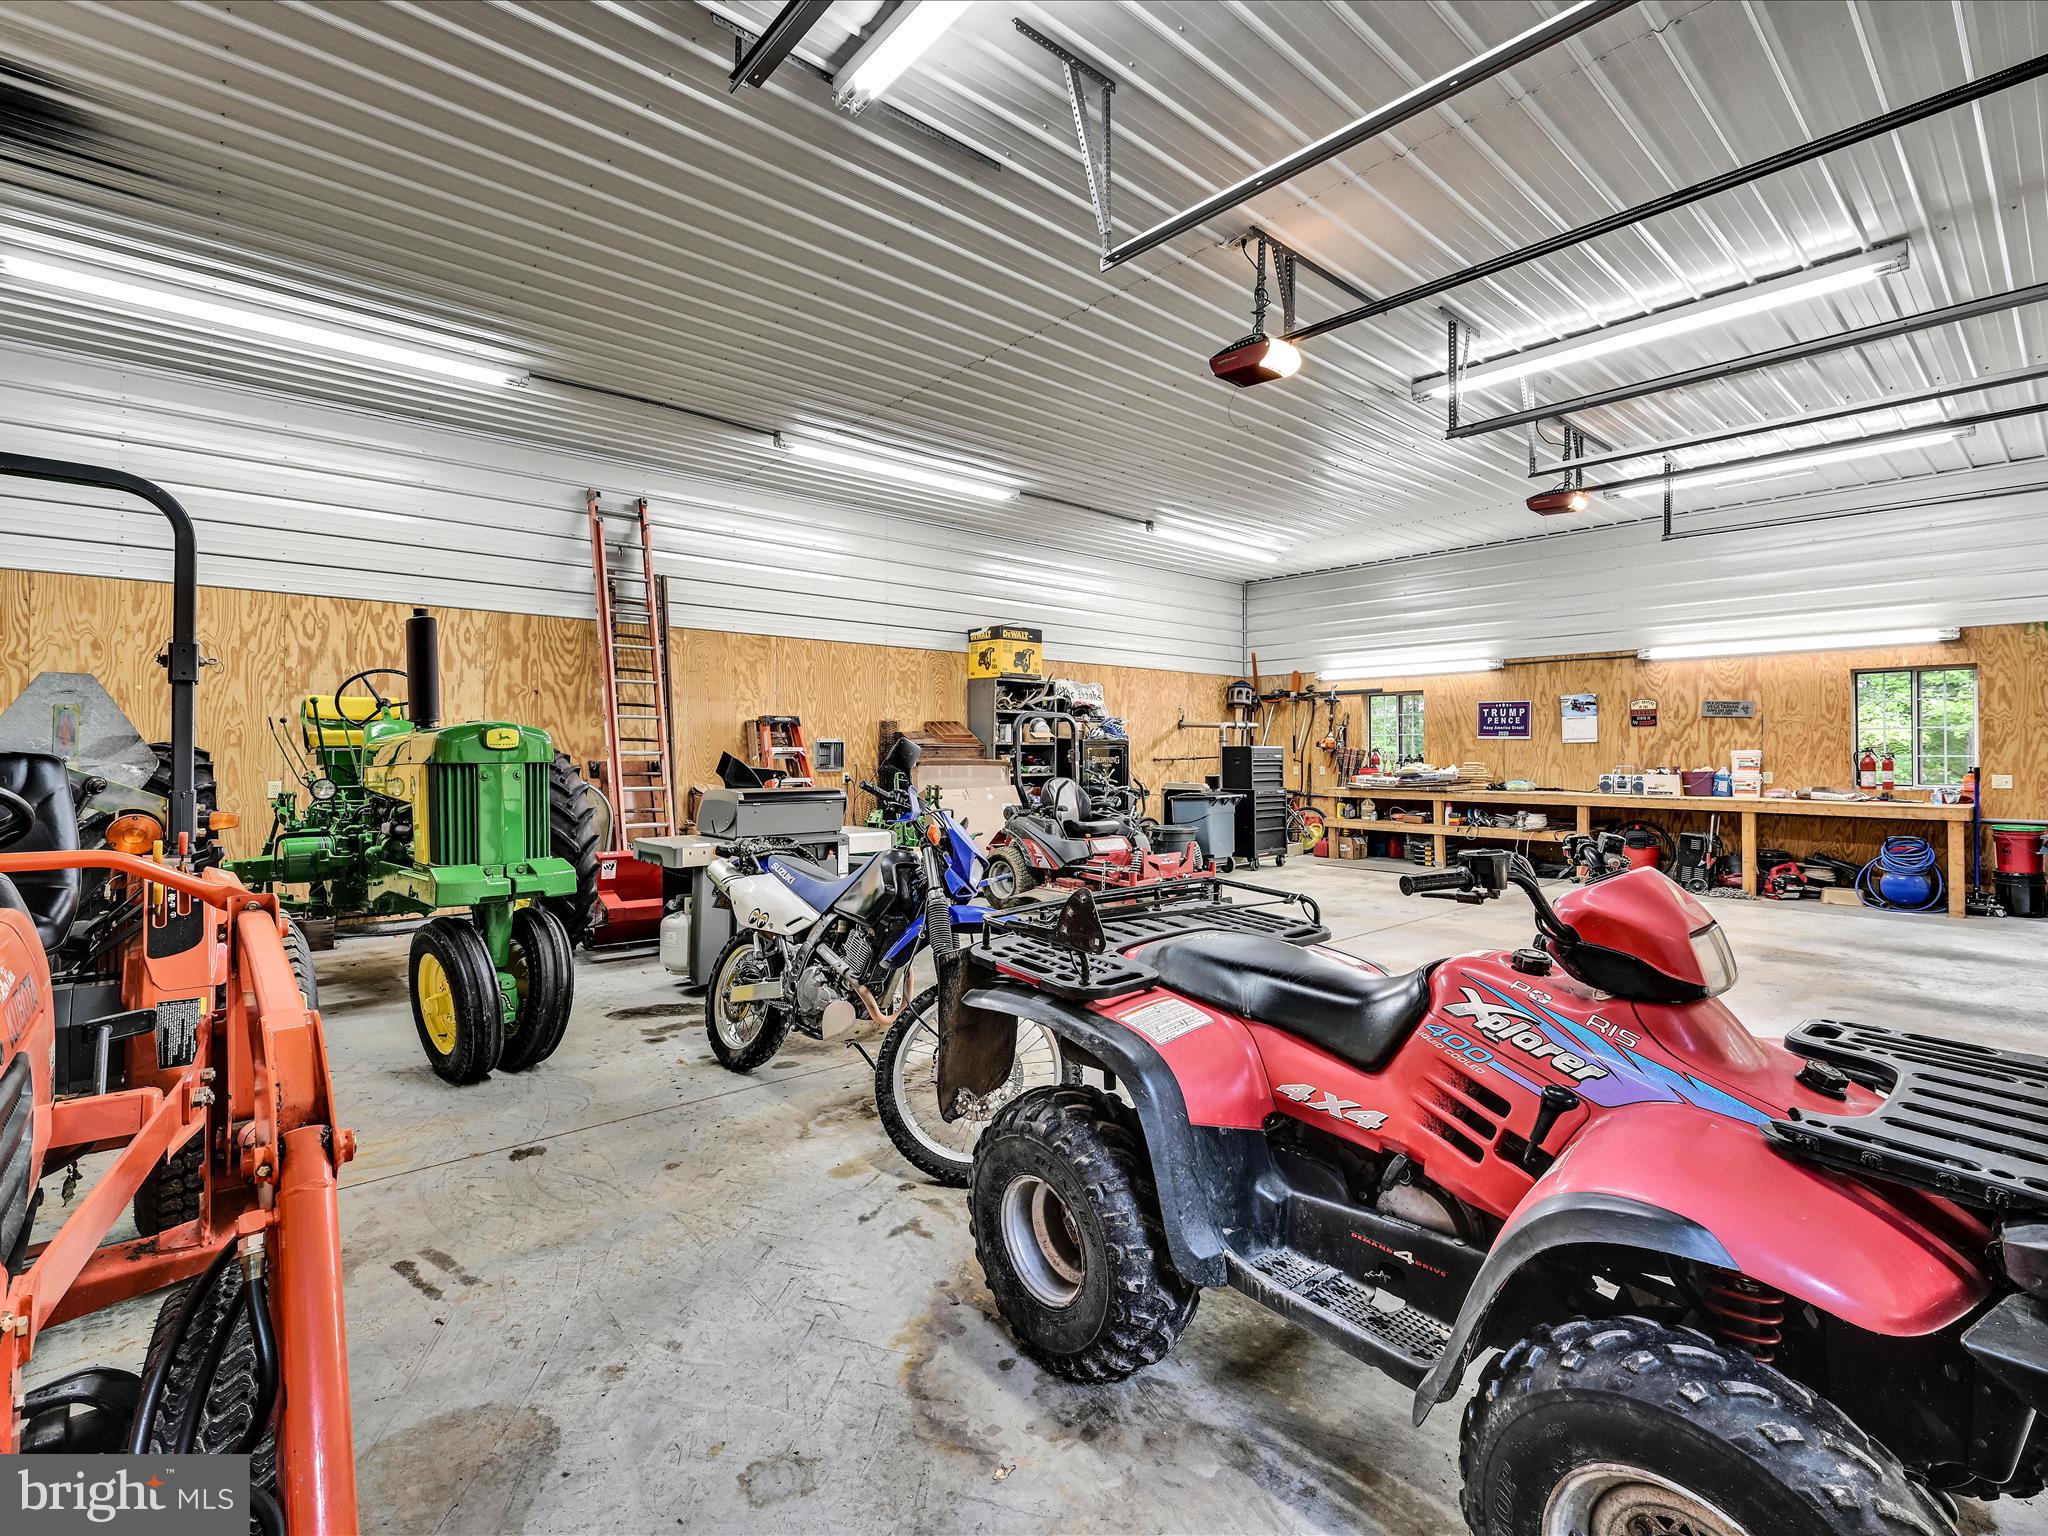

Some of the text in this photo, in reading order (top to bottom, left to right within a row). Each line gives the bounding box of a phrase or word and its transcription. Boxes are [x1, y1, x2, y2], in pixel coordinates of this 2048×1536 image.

[1482, 708, 1526, 717] TRUMP
[1091, 755, 1120, 765] BROWNING
[771, 862, 796, 885] SUZUKI
[1415, 1029, 1486, 1075] LIQUID COOLED
[1424, 1022, 1495, 1064] 400
[1443, 986, 1610, 1082] Xplorer
[1275, 1083, 1390, 1131] 4X4
[1350, 1231, 1394, 1255] DEMAND
[1414, 1259, 1448, 1278] DRIVE
